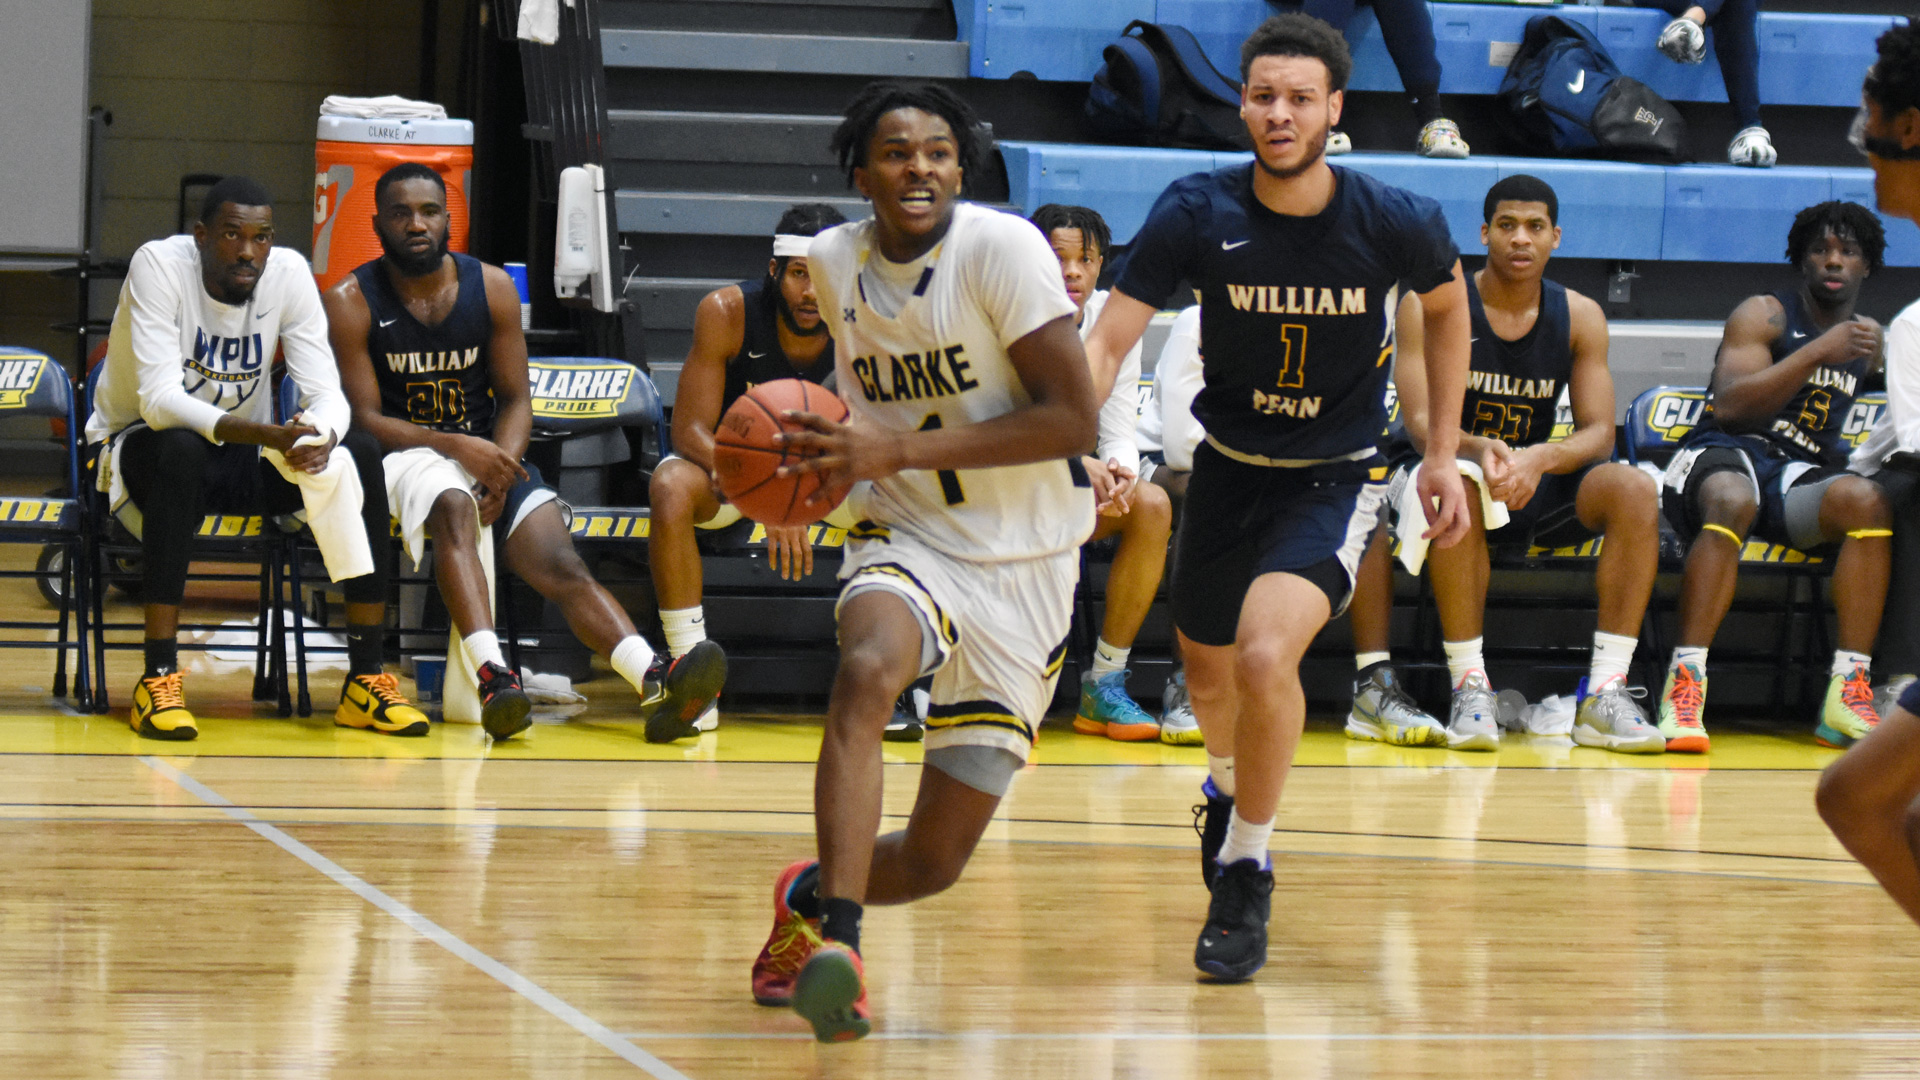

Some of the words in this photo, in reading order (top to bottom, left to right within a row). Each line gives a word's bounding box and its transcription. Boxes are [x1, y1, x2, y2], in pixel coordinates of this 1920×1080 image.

[368, 126, 400, 140] CLARKE
[404, 130, 417, 140] AT
[1226, 284, 1367, 315] WILLIAM
[193, 325, 262, 371] WPU
[385, 346, 478, 374] WILLIAM
[1277, 323, 1308, 388] 1
[0, 359, 41, 389] KE
[187, 359, 257, 381] BASKETBALL
[852, 343, 979, 403] CLARKE
[406, 378, 466, 424] 20
[543, 401, 598, 412] PRIDE
[1253, 388, 1323, 419] PENN
[1797, 389, 1832, 432] 5
[0, 501, 65, 522] IDE
[198, 515, 263, 536] IDE
[569, 517, 650, 538] PRID
